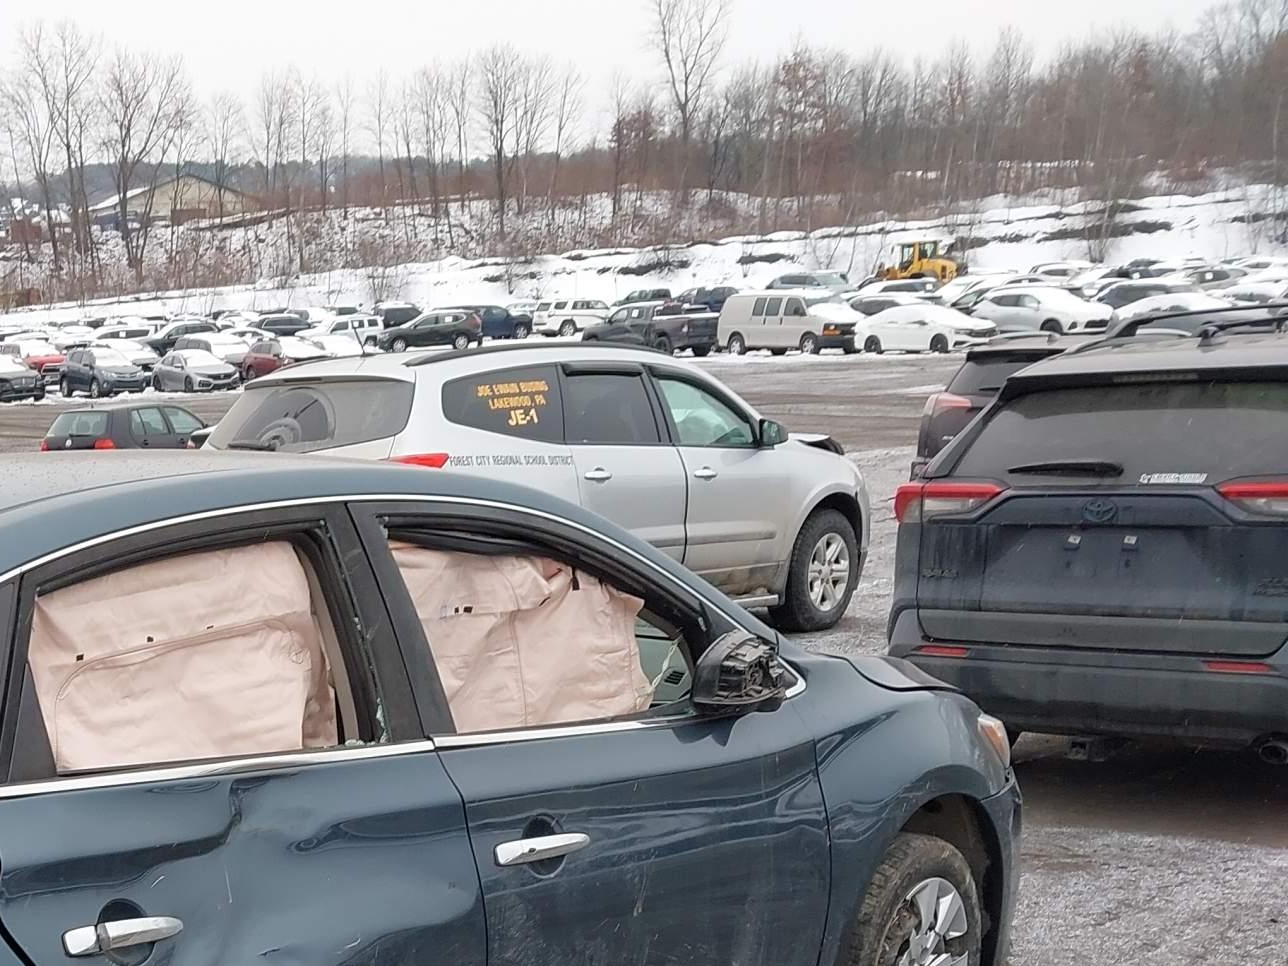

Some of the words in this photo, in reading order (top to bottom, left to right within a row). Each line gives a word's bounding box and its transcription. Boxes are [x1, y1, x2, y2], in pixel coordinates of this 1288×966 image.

[534, 394, 546, 405] PA
[508, 407, 539, 426] JE-1
[449, 455, 473, 467] FOREST
[475, 455, 490, 466] CITY
[492, 455, 523, 466] REGIONAL
[524, 455, 548, 466] SCHOOL
[548, 455, 573, 466] DISTRICT
